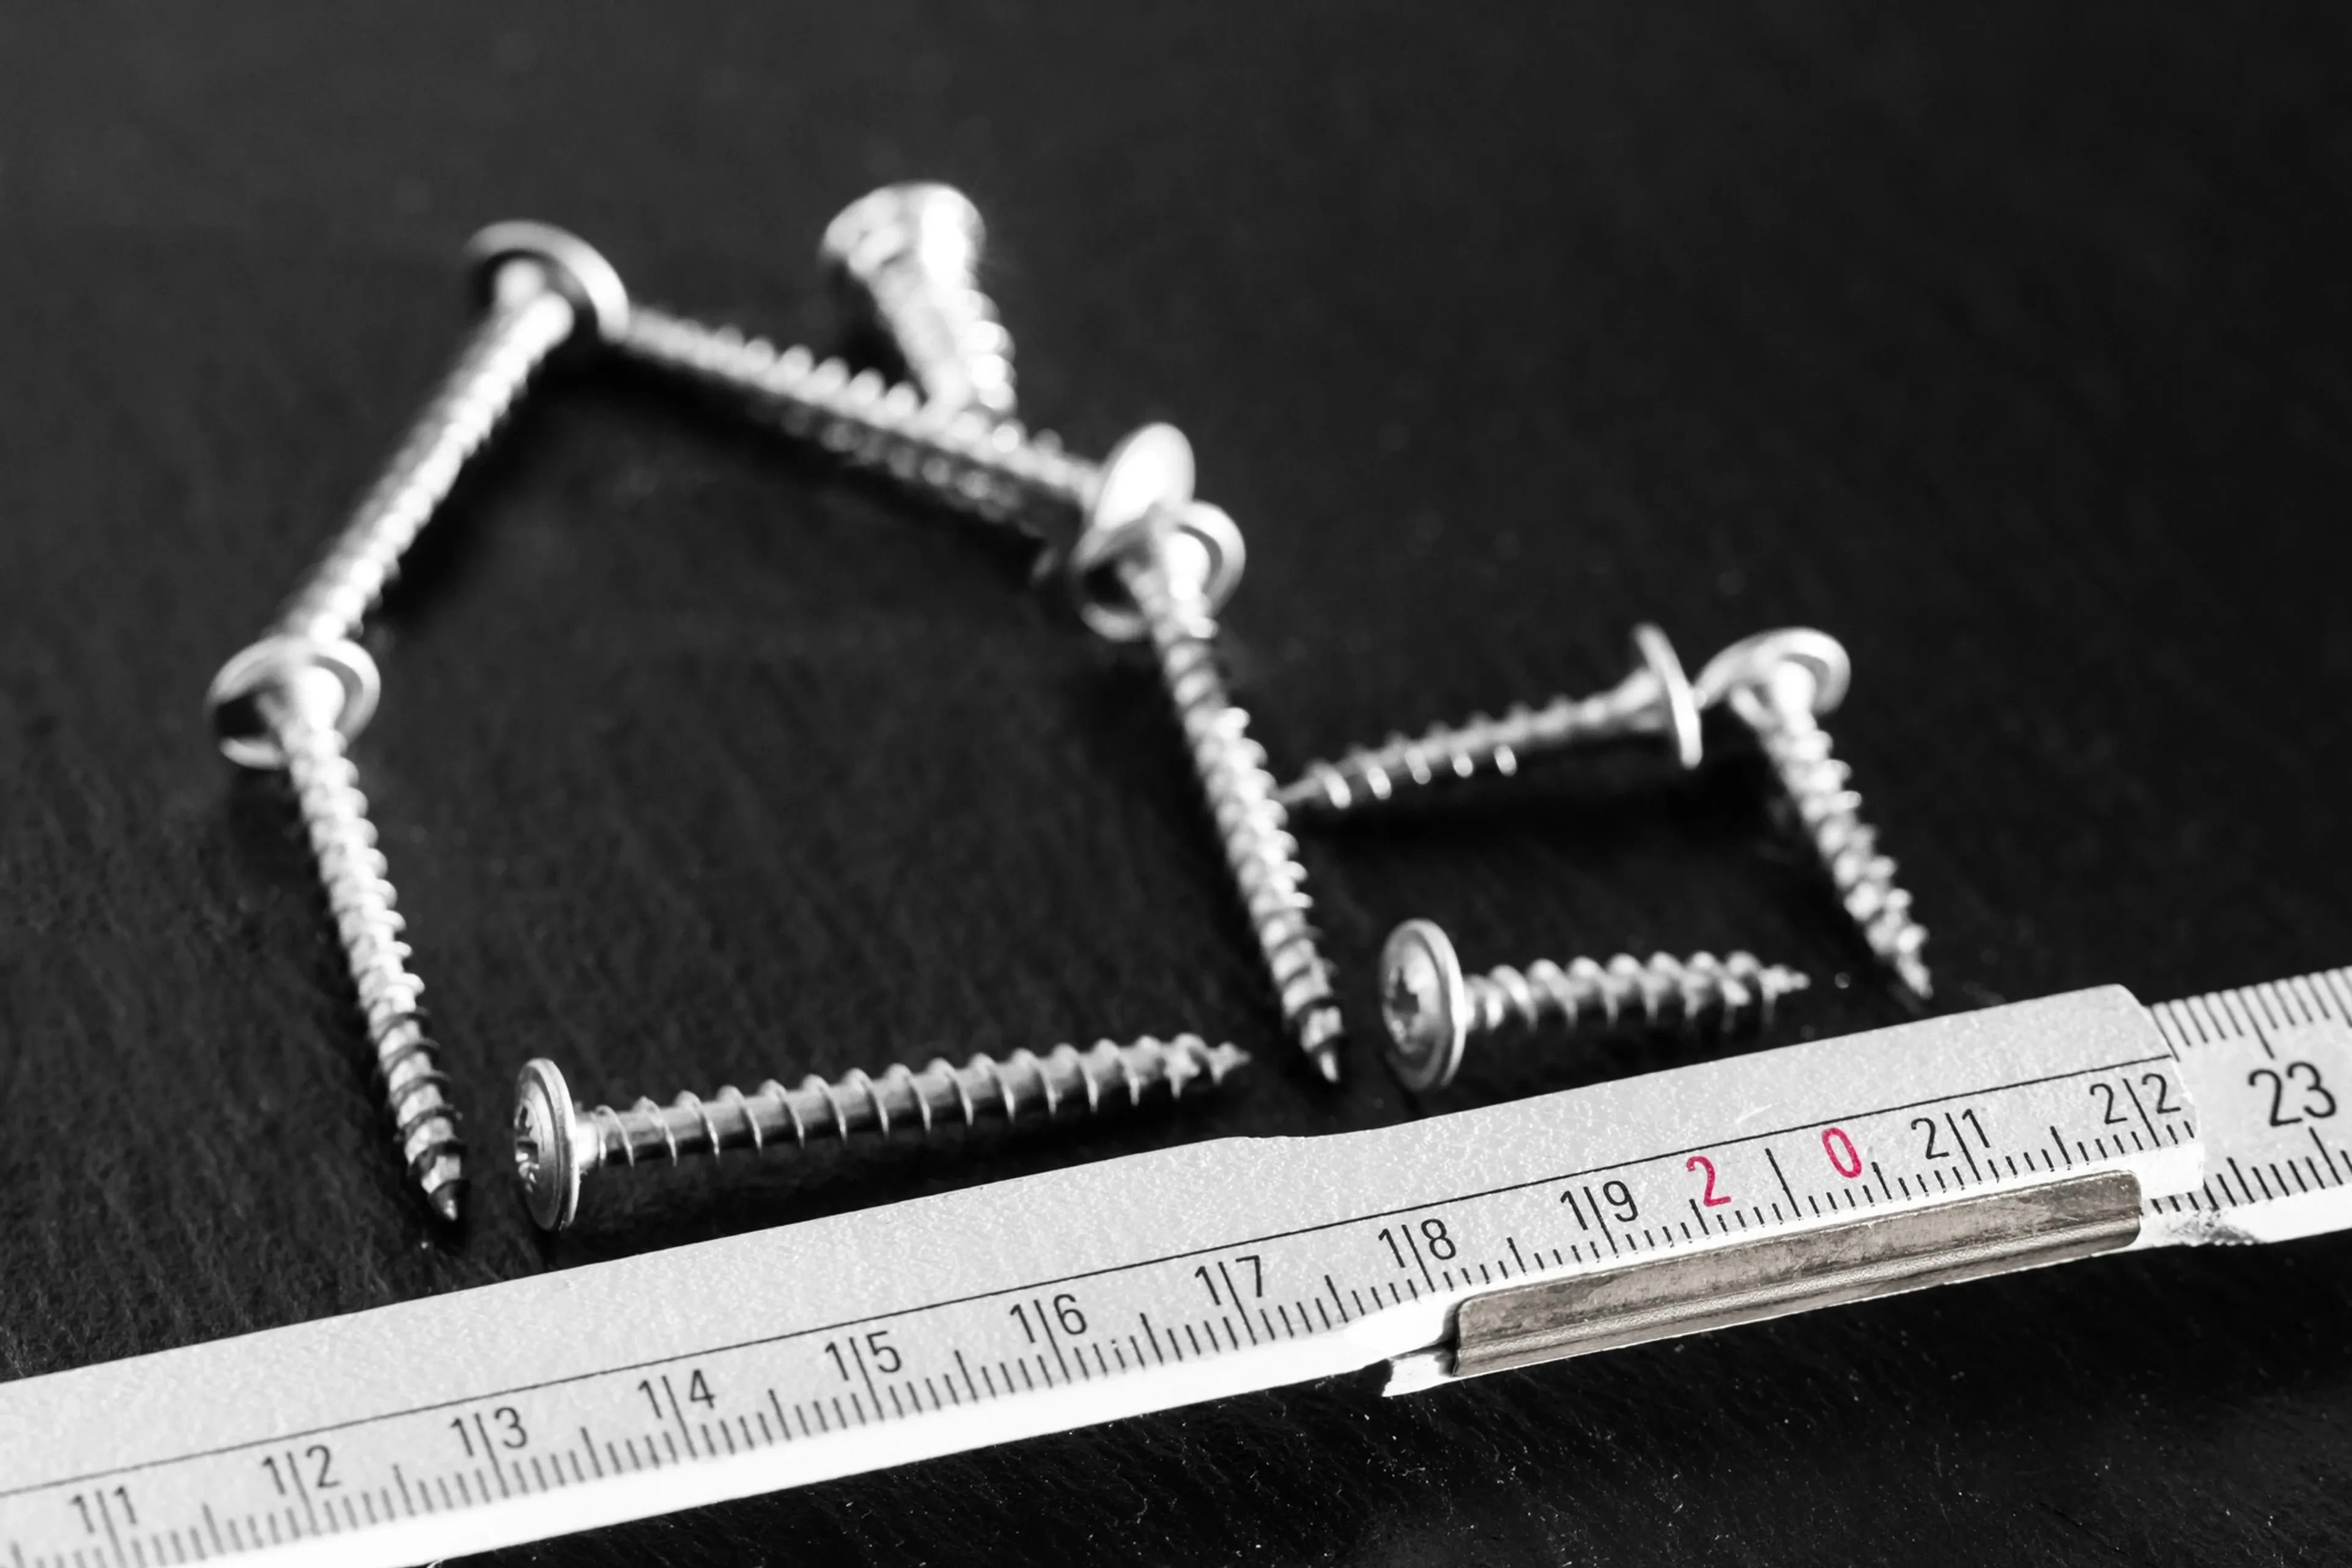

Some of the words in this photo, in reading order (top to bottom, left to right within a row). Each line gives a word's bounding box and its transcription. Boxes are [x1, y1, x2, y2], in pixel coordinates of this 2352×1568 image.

[2249, 1062, 2337, 1127] 23
[70, 1485, 137, 1534] 11
[262, 1445, 341, 1495] 12
[450, 1407, 528, 1457] 13
[638, 1369, 716, 1418] 14
[824, 1331, 902, 1381] 15
[1010, 1294, 1087, 1343] 16
[1195, 1255, 1262, 1305] 17
[1378, 1219, 1456, 1268] 18
[1561, 1180, 1637, 1230] 19
[1911, 1109, 1990, 1160] 21
[2089, 1073, 2181, 1124] 22
